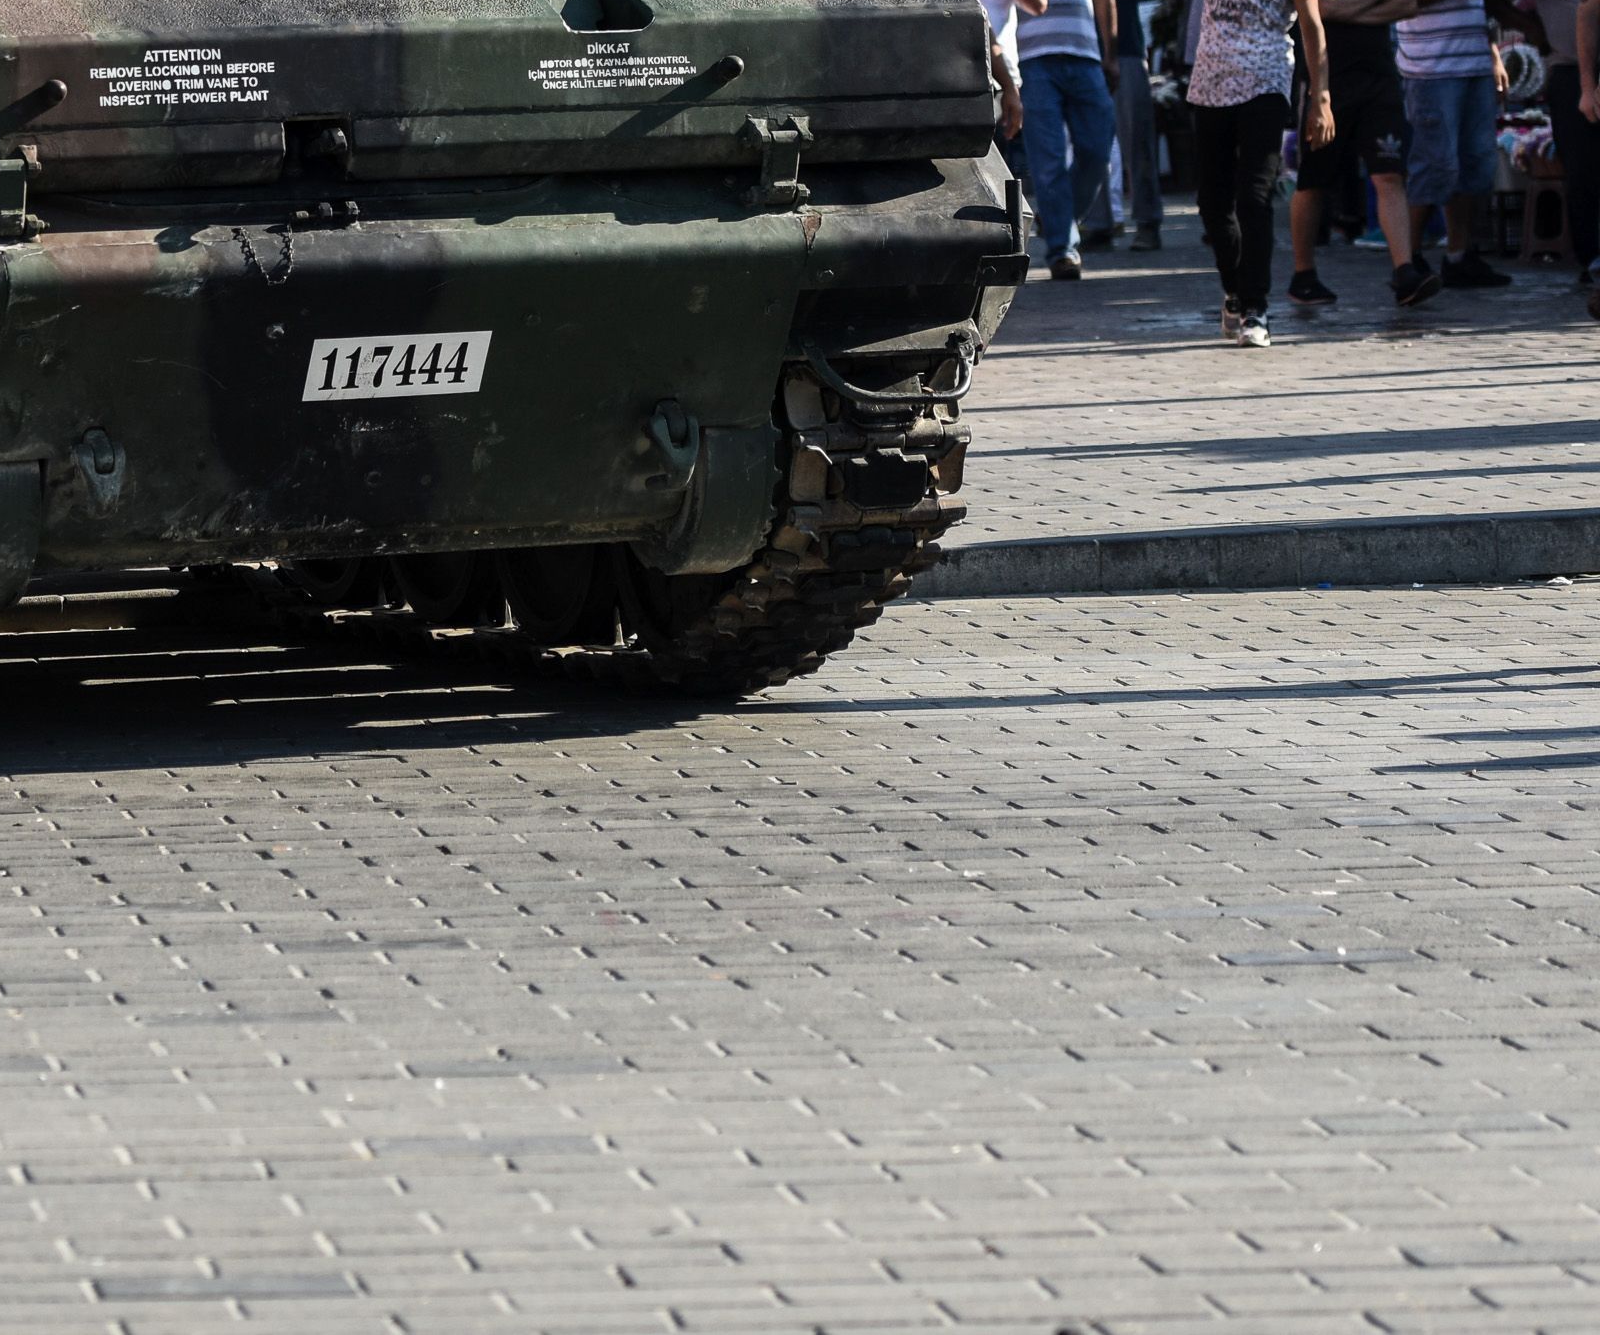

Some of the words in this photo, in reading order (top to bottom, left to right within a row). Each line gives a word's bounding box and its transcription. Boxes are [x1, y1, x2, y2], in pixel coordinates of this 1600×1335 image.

[143, 49, 221, 63] ATTENTION
[587, 42, 630, 55] DİKKAT
[540, 59, 573, 68] MOTOR
[647, 56, 690, 65] KONTROL
[89, 67, 142, 79] REMOVE
[145, 65, 200, 77] LOCKING
[203, 64, 223, 75] PIN
[226, 62, 275, 74] BEFORE
[109, 80, 172, 92] LOVERING
[174, 79, 204, 90] TRIM
[207, 77, 239, 89] VANE
[242, 76, 258, 88] TO
[99, 95, 151, 107] INSPECT
[155, 93, 179, 104] THE
[182, 92, 226, 104] POWER
[230, 90, 269, 102] PLANT
[317, 341, 469, 391] 117444
